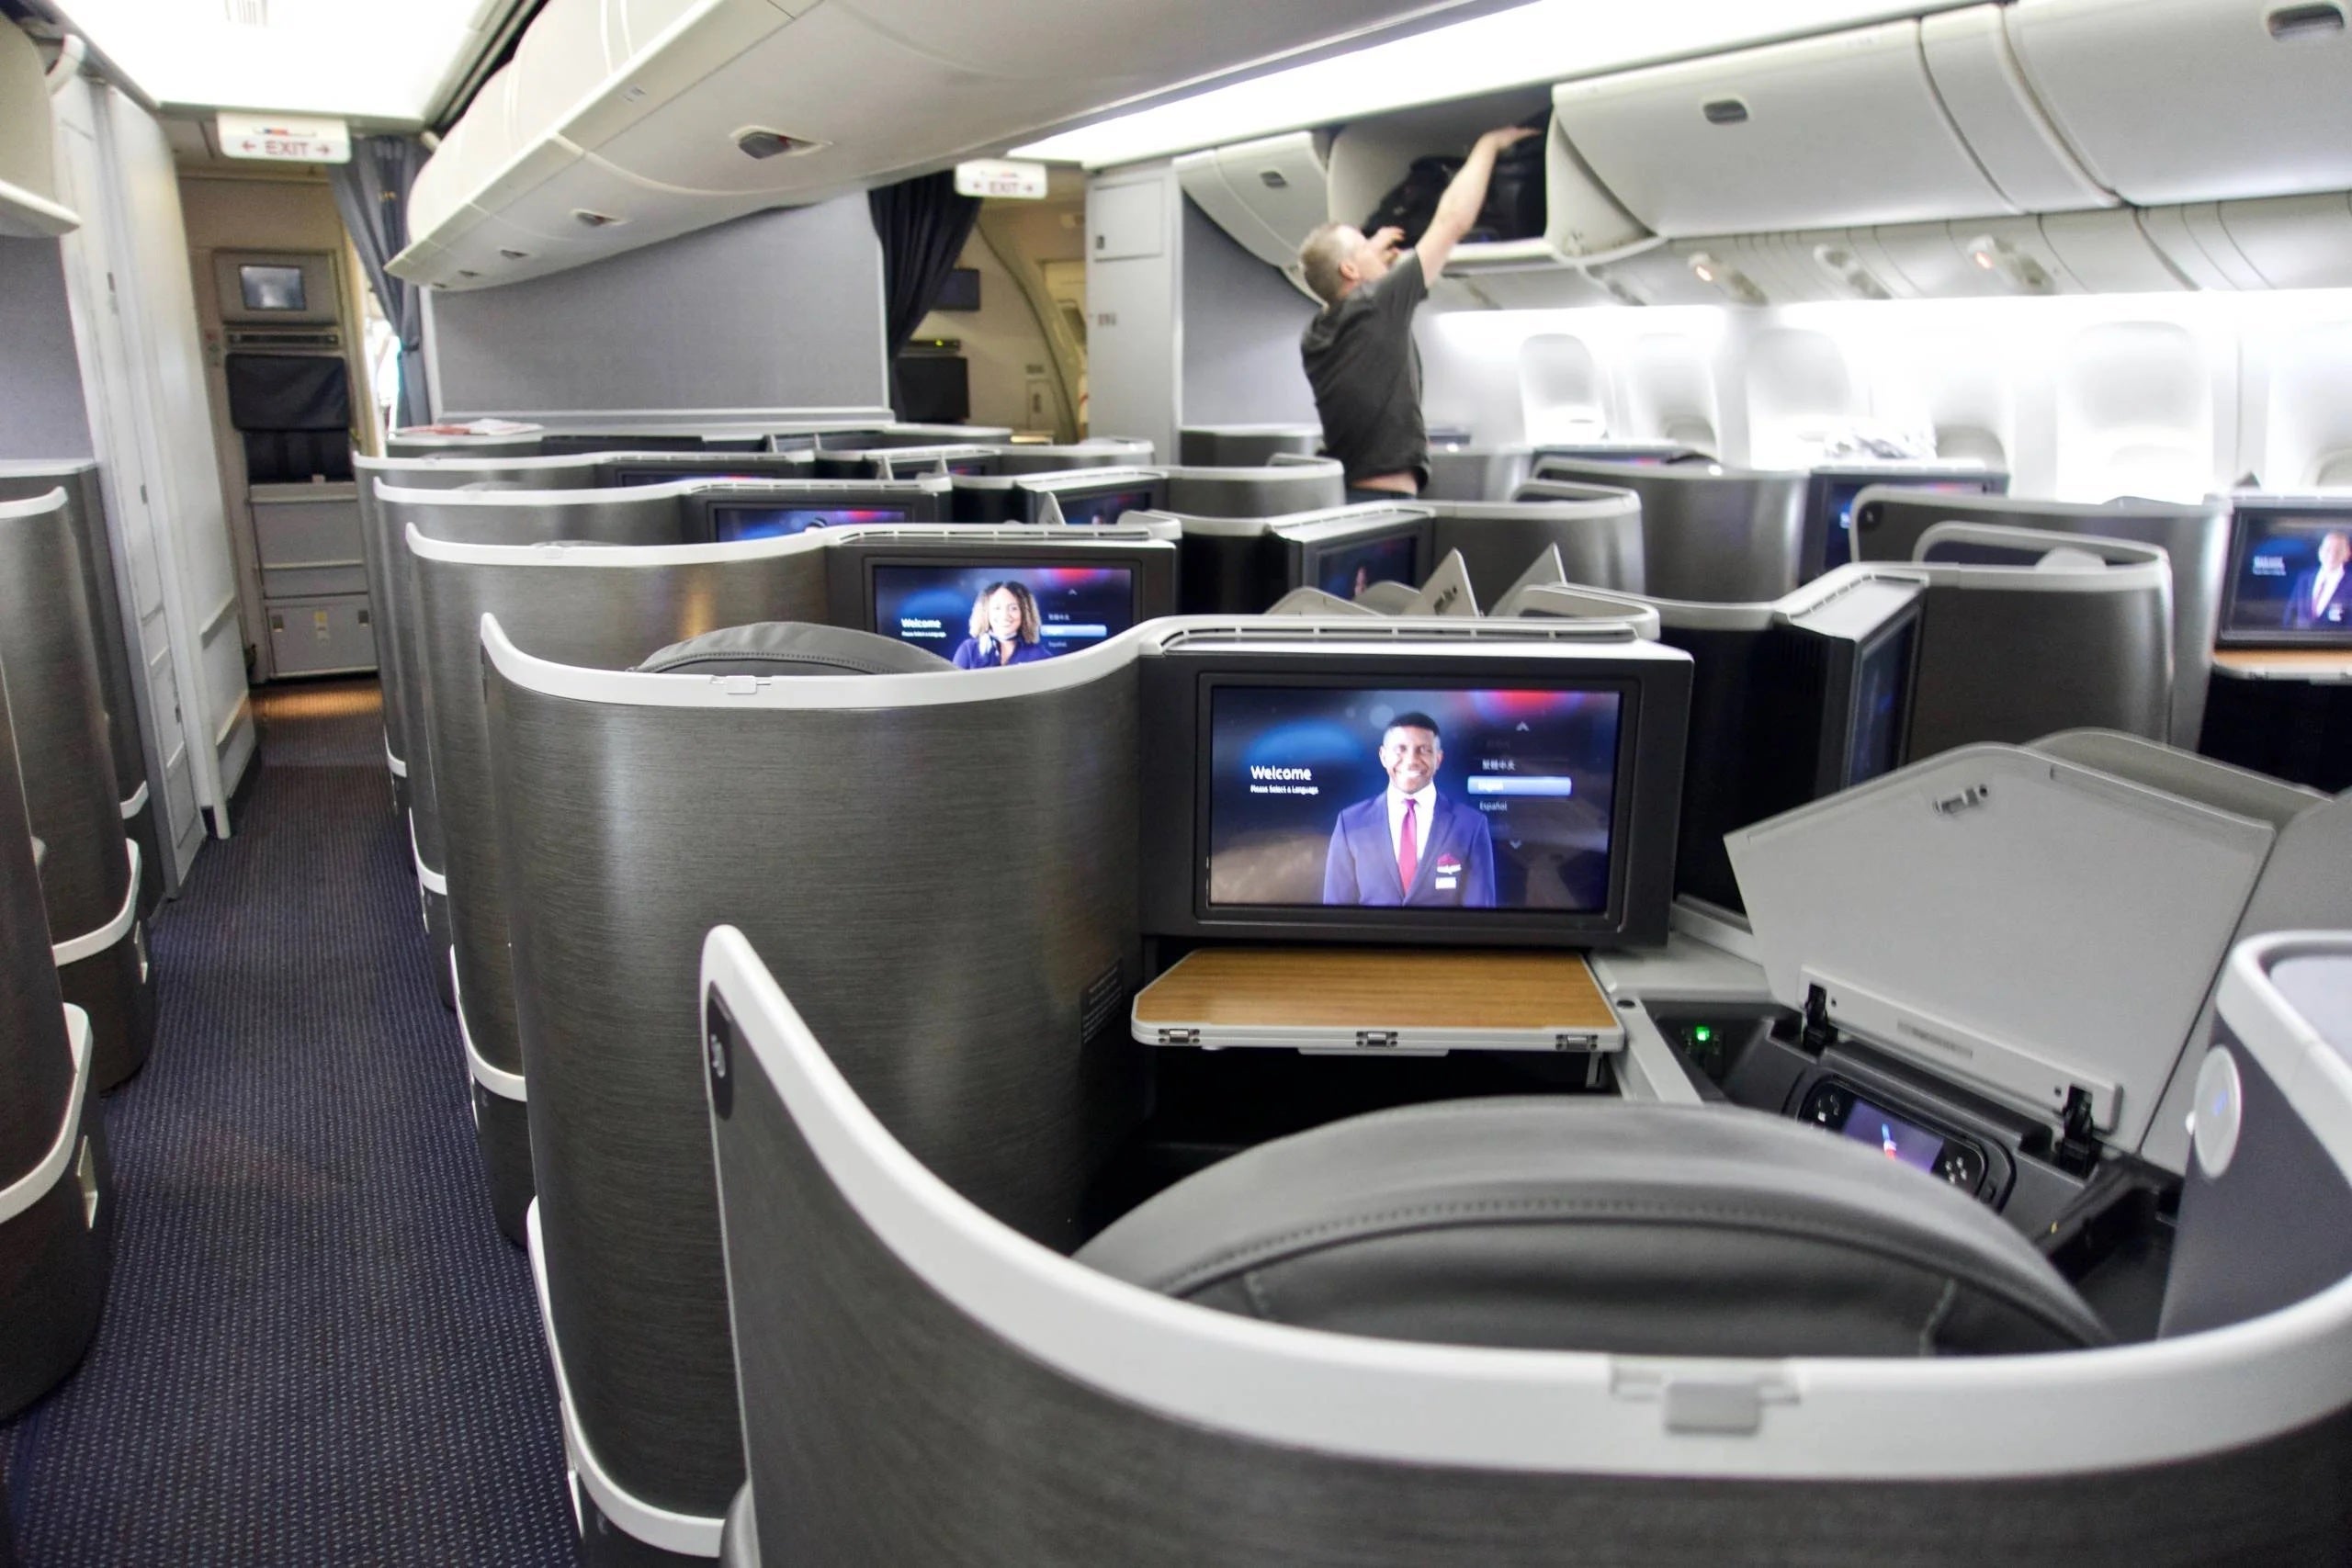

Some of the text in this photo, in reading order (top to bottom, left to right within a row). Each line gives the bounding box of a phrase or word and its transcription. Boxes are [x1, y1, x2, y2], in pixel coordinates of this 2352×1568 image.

[264, 141, 309, 155] EXIT
[989, 181, 1018, 193] EXIT
[900, 617, 942, 628] Welcome
[1250, 764, 1312, 781] Welcome
